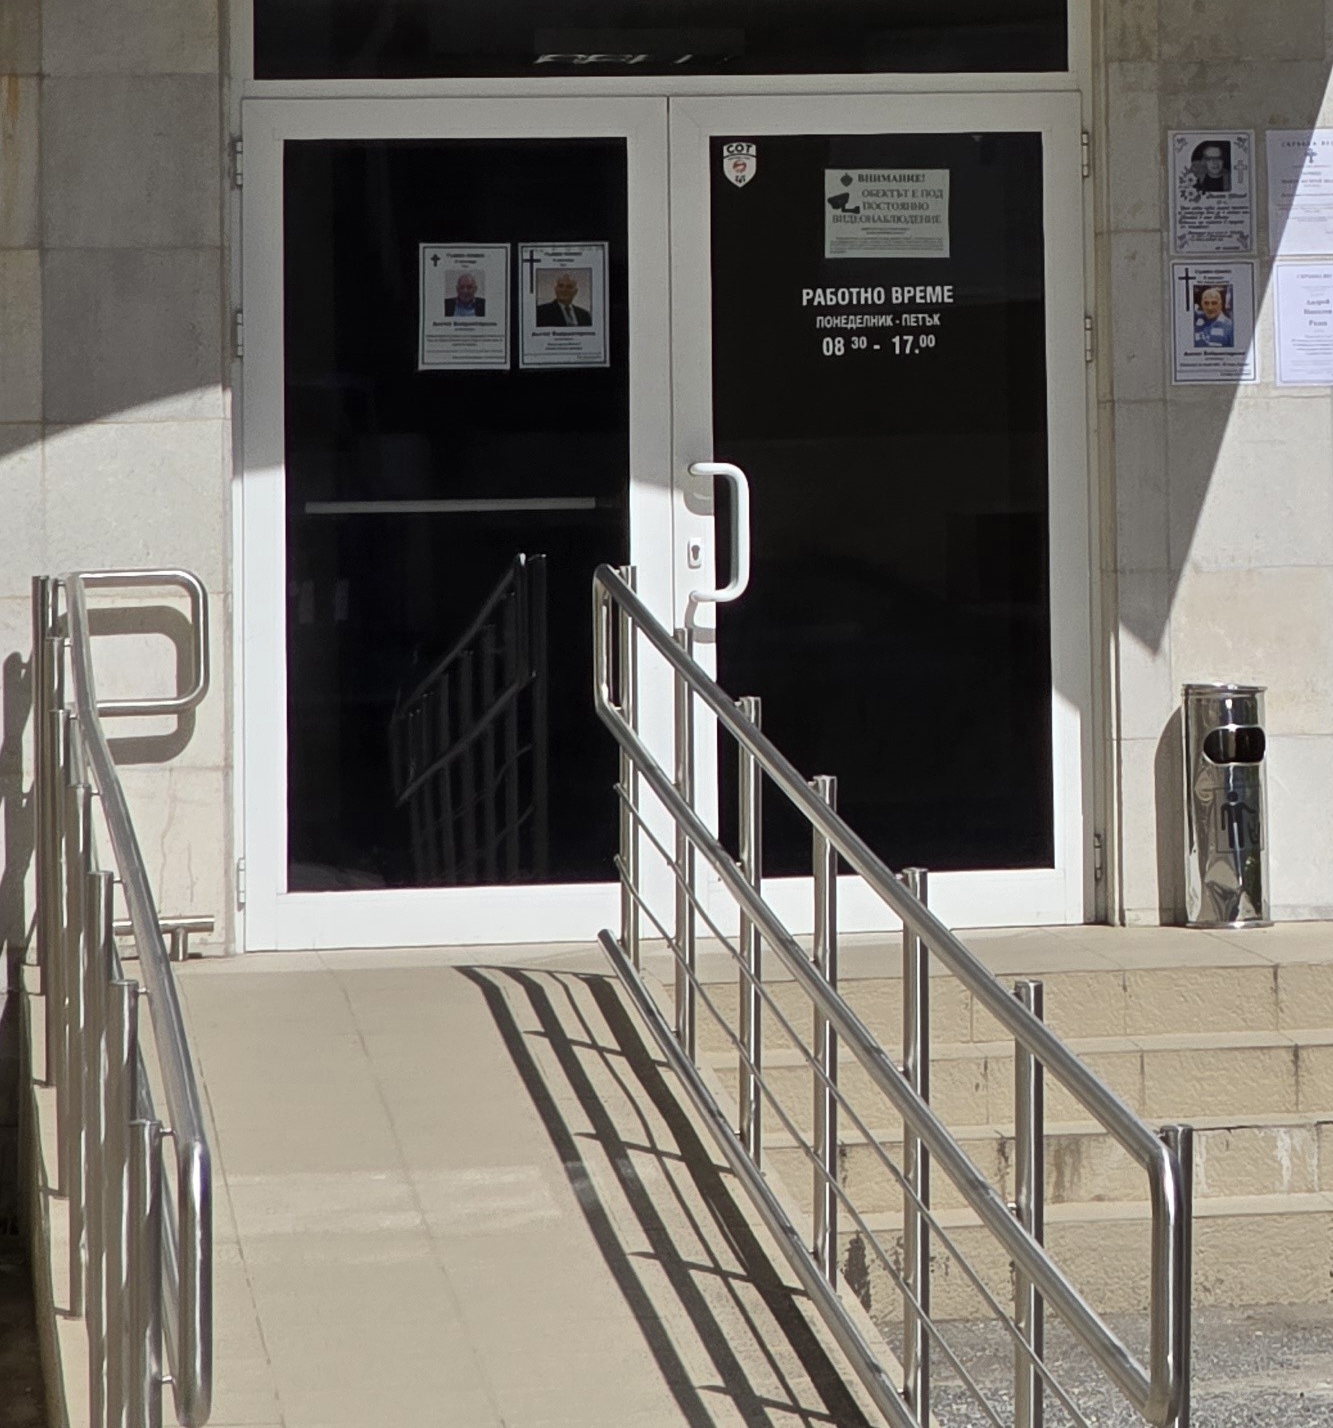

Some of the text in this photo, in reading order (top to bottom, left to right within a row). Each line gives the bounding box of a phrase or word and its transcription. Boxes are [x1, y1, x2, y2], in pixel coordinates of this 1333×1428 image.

[857, 173, 926, 183] ВНИМАНИЕ!
[861, 189, 909, 199] ОБЕКТЪТ
[921, 189, 944, 200] ПОД
[862, 201, 930, 211] ПОСТОЯННО
[832, 215, 942, 225] ВИДЕОНАБЛЮДЕНИЕ
[802, 285, 954, 306] РАБОТНО ВРЕМЕ
[816, 314, 893, 330] ПОНЕДЕЛНИК
[901, 313, 941, 327] ПЕТЪК
[822, 336, 845, 356] 08
[851, 336, 867, 349] 30
